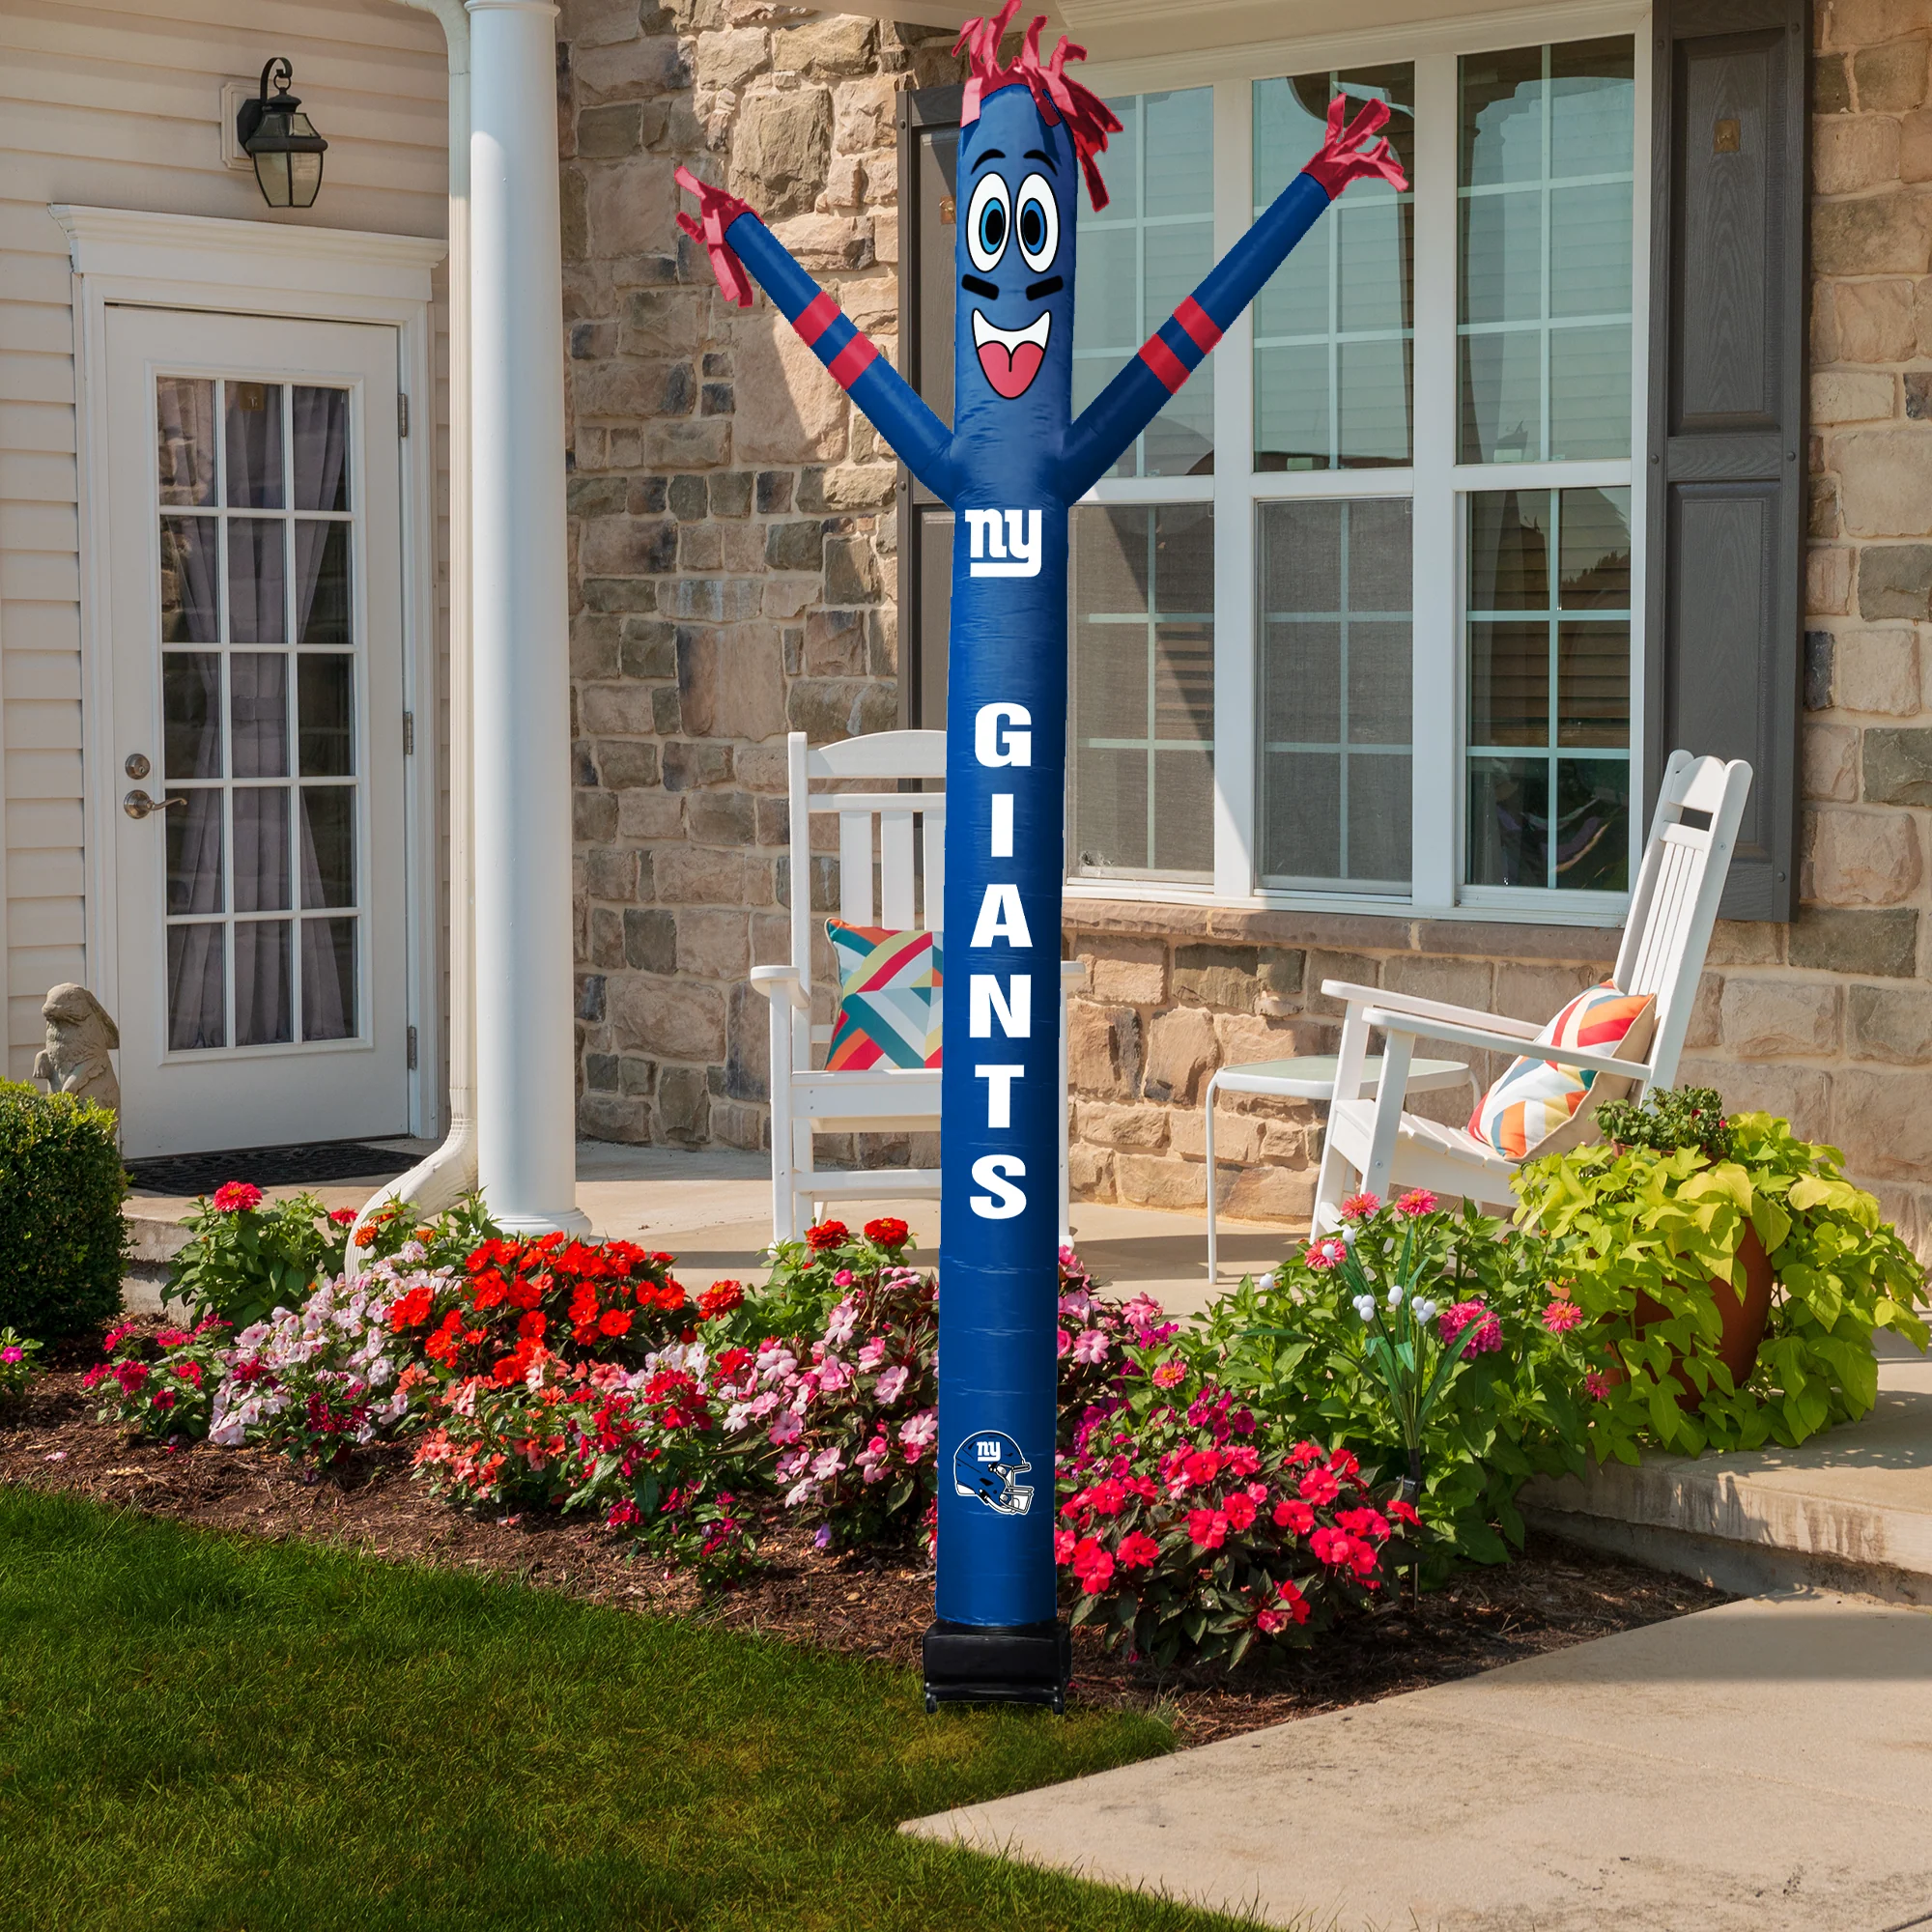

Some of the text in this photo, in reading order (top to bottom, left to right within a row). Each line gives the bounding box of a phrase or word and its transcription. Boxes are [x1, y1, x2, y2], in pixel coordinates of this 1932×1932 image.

[965, 509, 1042, 578] ny
[969, 702, 1033, 1220] GIANTS
[977, 1441, 1001, 1462] ny
